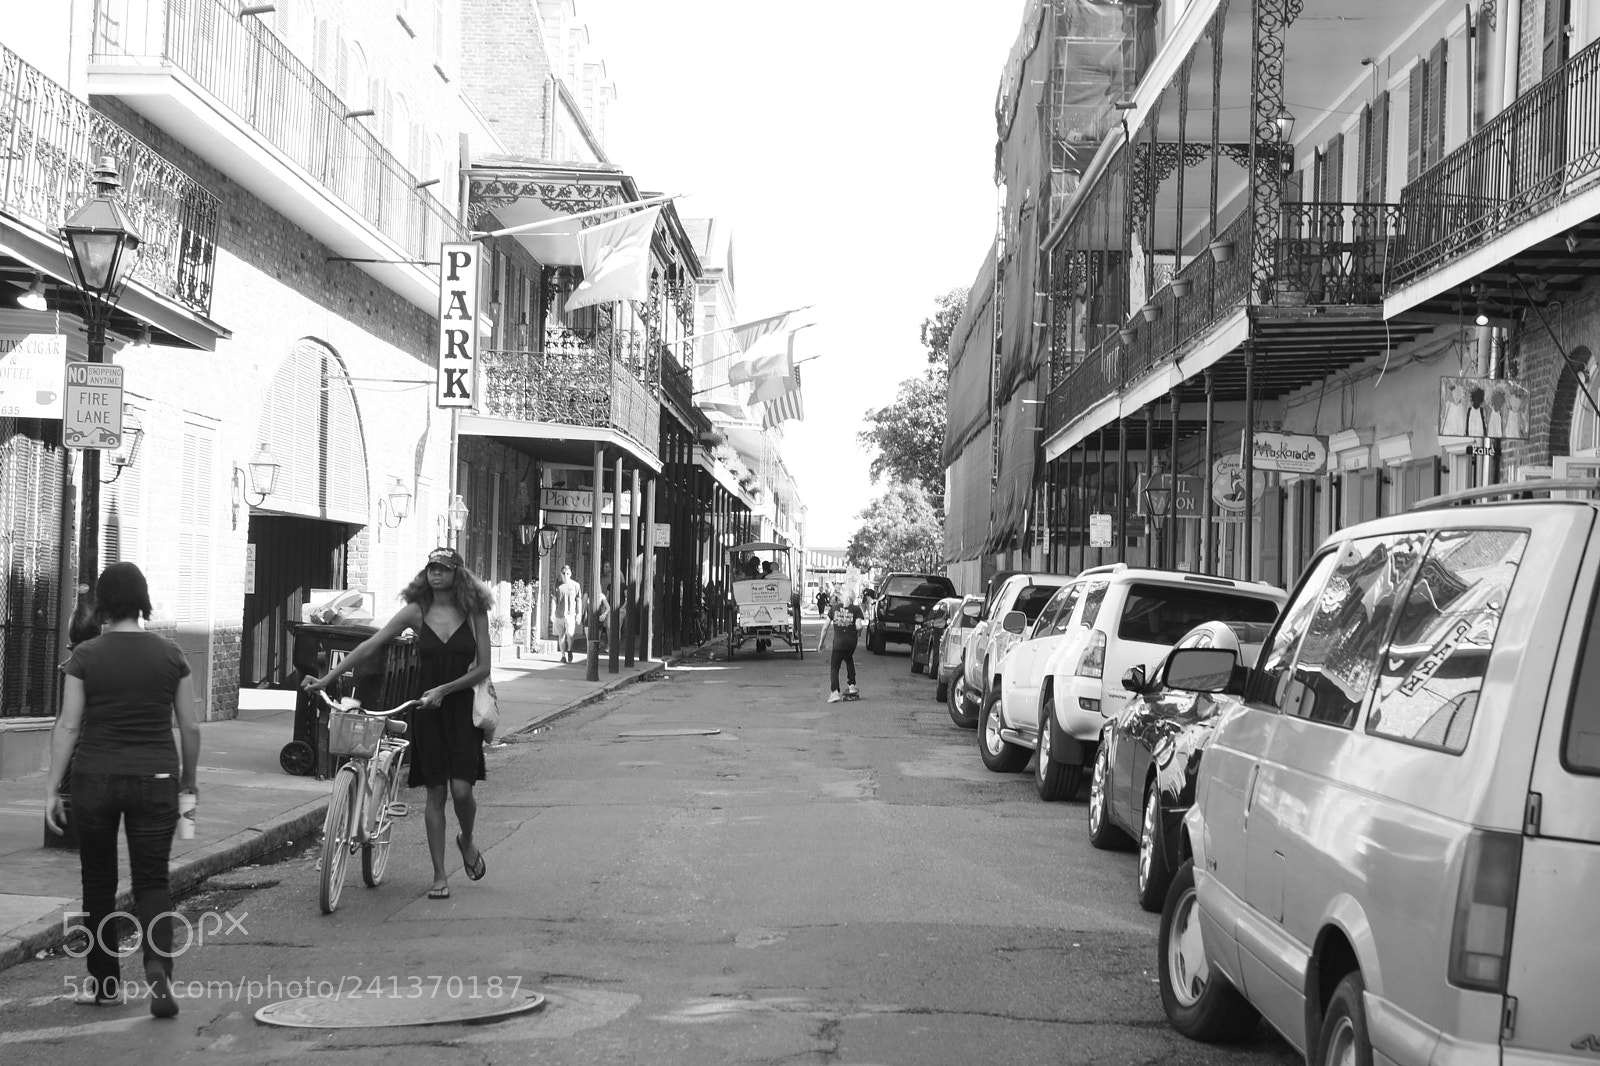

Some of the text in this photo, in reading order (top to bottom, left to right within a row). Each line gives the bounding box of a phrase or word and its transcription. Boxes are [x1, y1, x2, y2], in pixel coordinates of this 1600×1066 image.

[443, 251, 472, 398] PARK
[27, 340, 60, 355] CIGAR
[68, 367, 121, 383] NO STOPPING
[90, 377, 119, 385] ANYTIME
[80, 392, 109, 406] FIRE
[1, 405, 20, 415] 635
[77, 410, 110, 424] LANE
[545, 490, 580, 507] Place
[1151, 495, 1195, 510] SAON
[566, 514, 609, 526] HOTL
